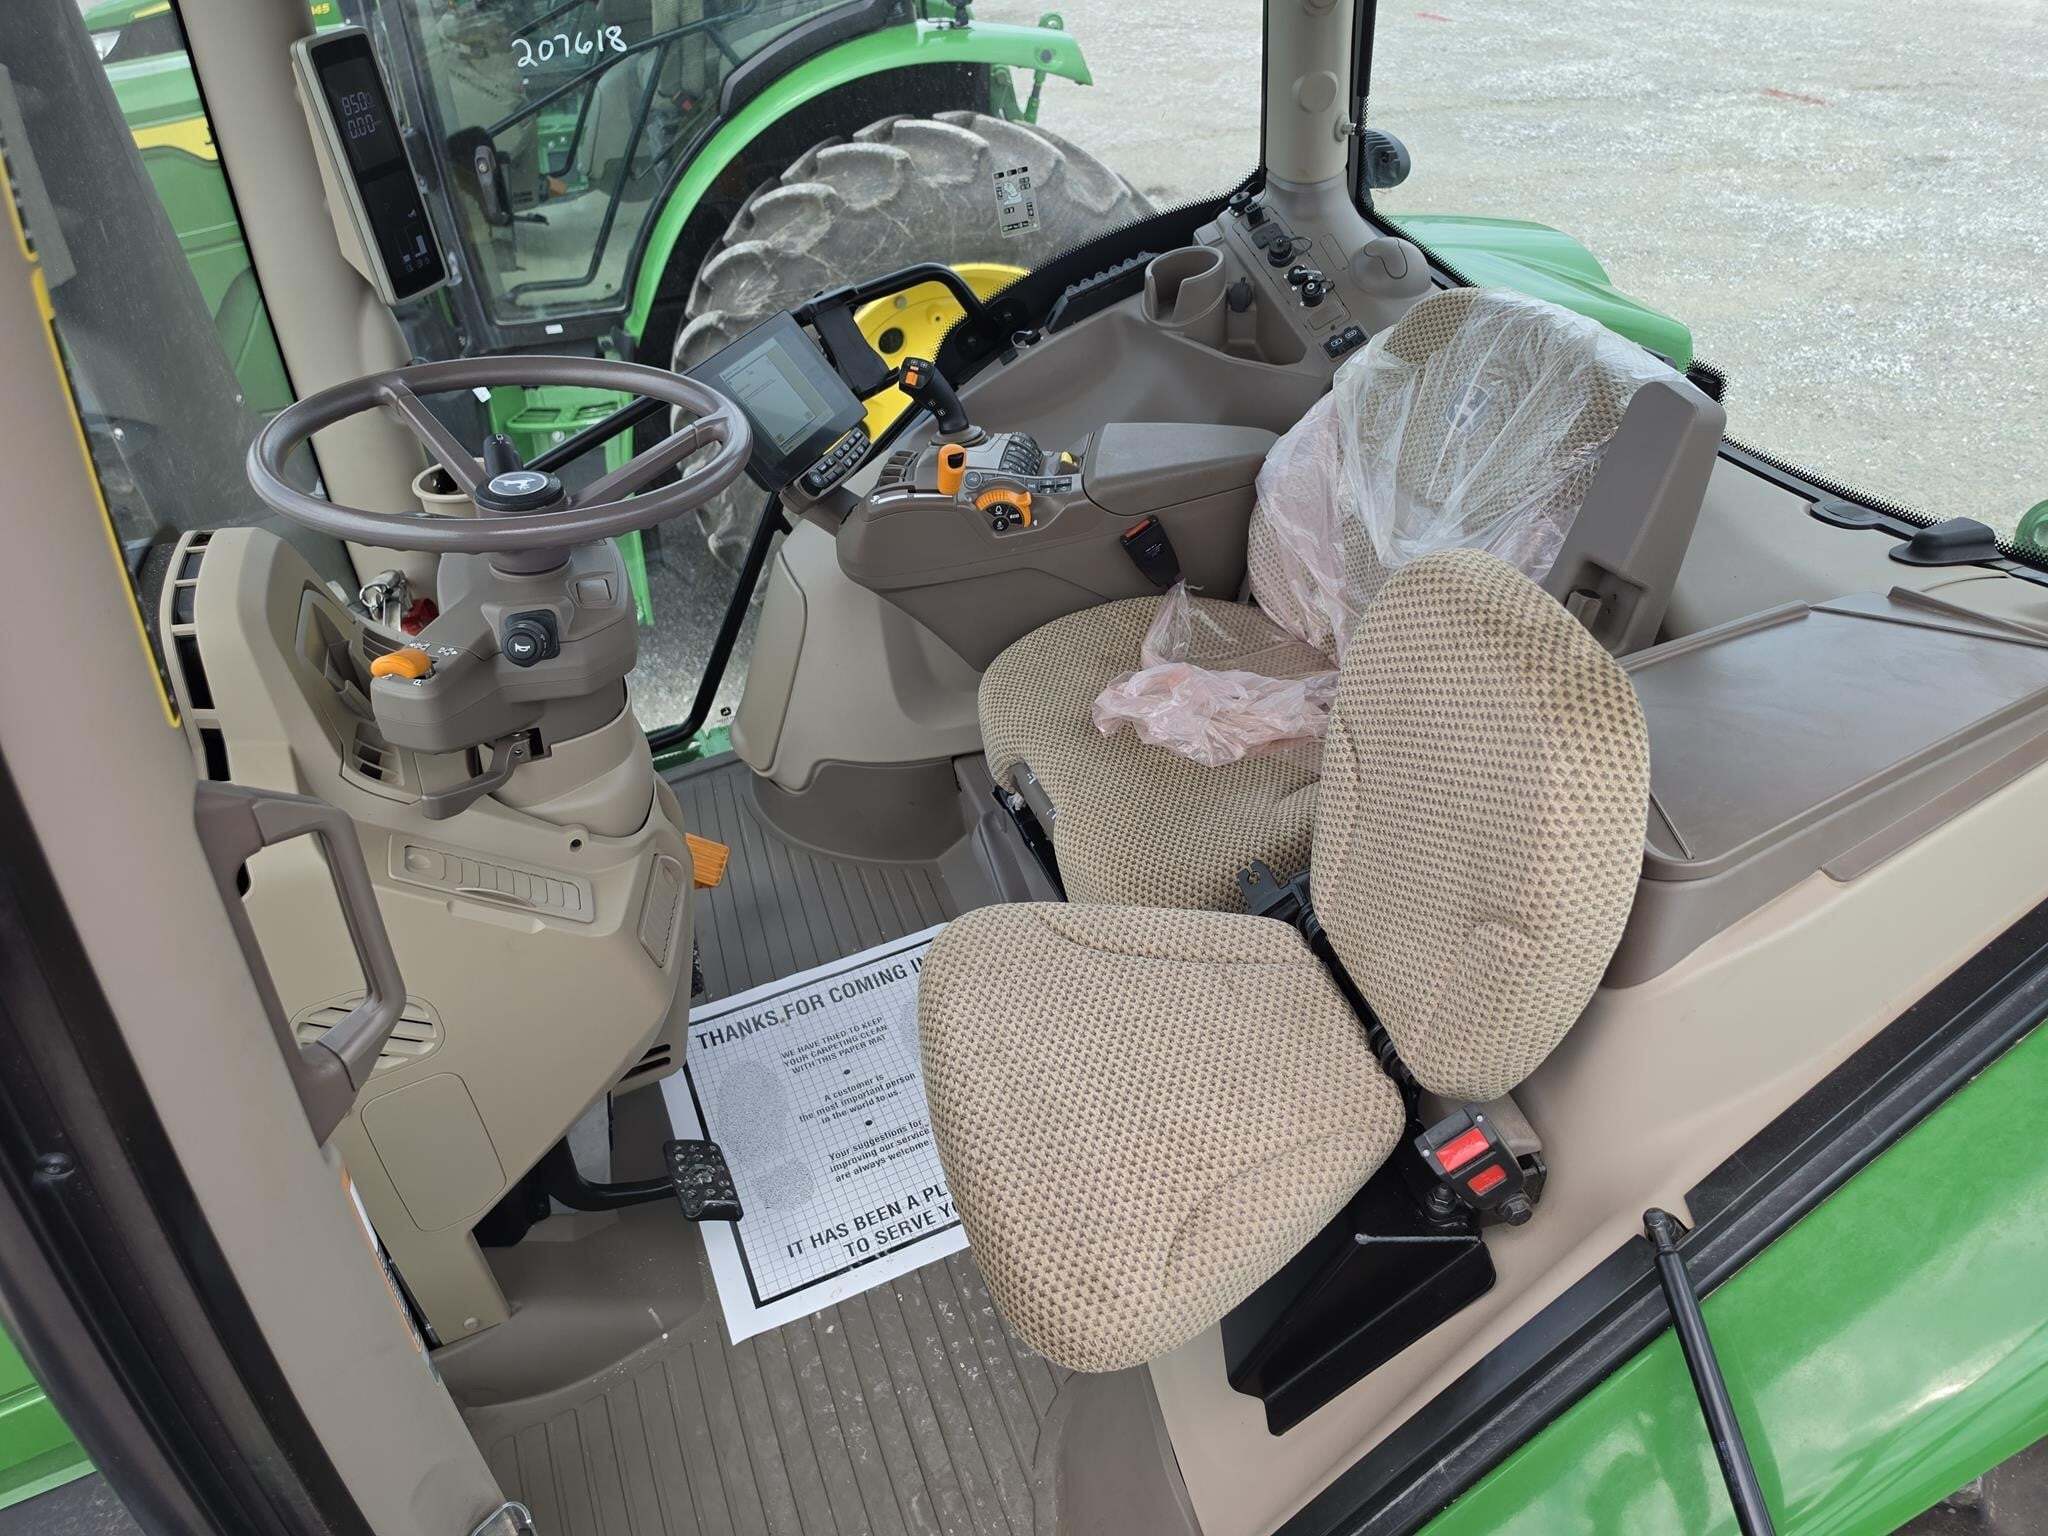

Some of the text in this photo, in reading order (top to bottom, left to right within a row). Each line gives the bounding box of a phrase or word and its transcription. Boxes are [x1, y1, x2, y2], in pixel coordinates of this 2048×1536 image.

[512, 26, 627, 67] 207618
[695, 1010, 779, 1049] THANKS
[783, 994, 825, 1020] FOR
[828, 964, 908, 1003] COMING
[781, 1016, 883, 1059] WE HAVE TRIED TO KEEP
[784, 1024, 888, 1067] YOUR CARPETING CLEAN
[791, 1034, 887, 1074] WITH THIS PAPER MAT
[799, 1072, 916, 1122] the most important person
[824, 1074, 885, 1102] A customer is
[832, 1110, 848, 1119] the
[848, 1099, 875, 1113] world
[875, 1095, 886, 1103] to
[887, 1089, 902, 1098] us.
[828, 1119, 922, 1161] Your suggestions for
[829, 1128, 930, 1173] improving our service
[835, 1171, 851, 1182] are
[853, 1156, 887, 1175] always
[787, 1239, 804, 1258] IT
[809, 1223, 849, 1249] HAS
[853, 1201, 903, 1232] BEEN
[907, 1194, 920, 1210] A
[843, 1237, 870, 1257] TO
[874, 1210, 936, 1245] SERVE
